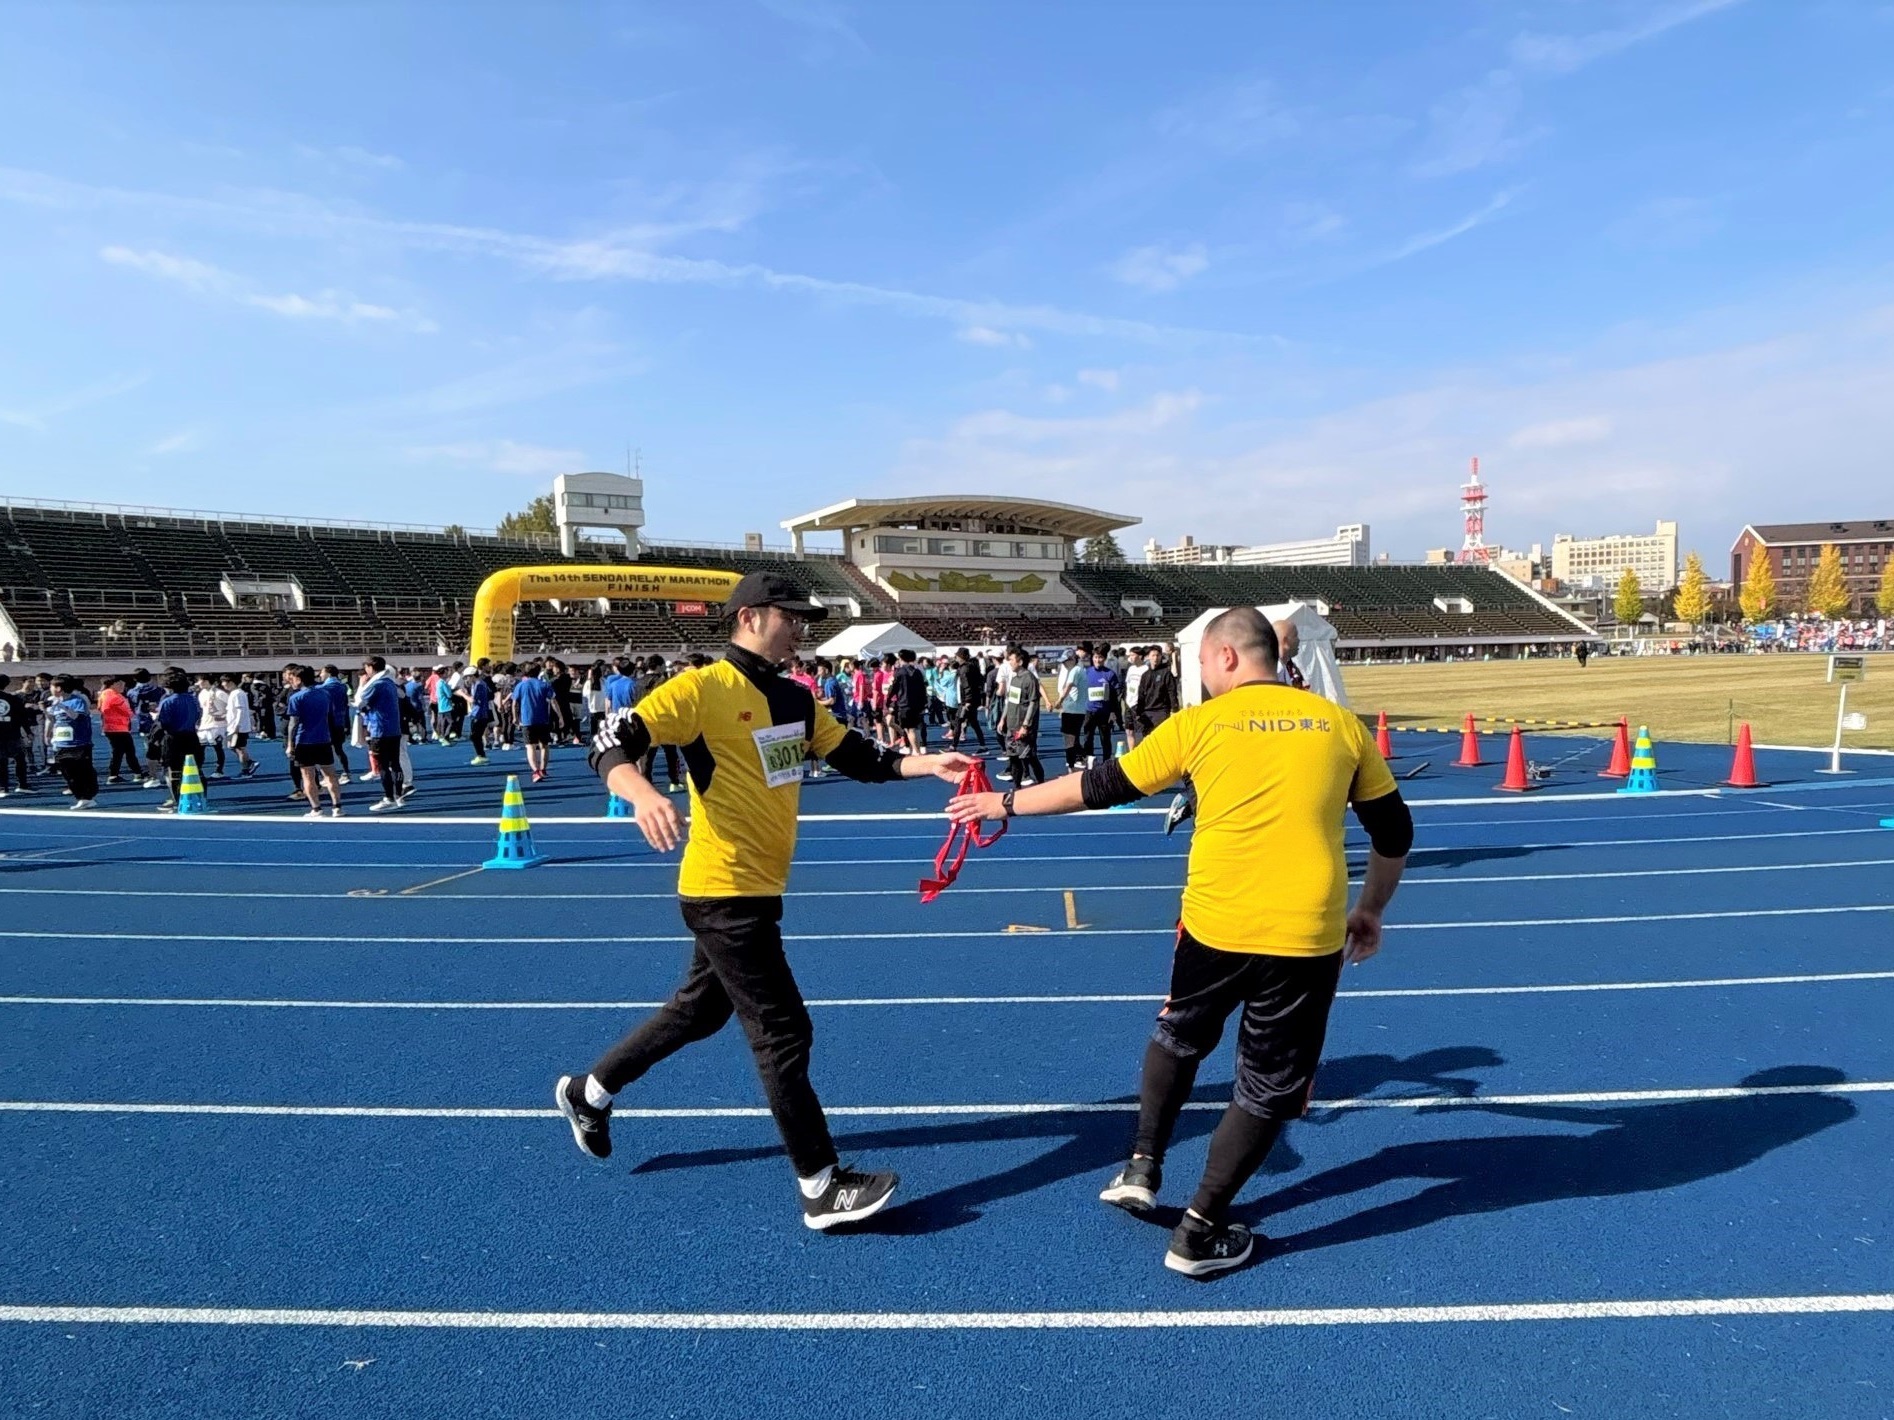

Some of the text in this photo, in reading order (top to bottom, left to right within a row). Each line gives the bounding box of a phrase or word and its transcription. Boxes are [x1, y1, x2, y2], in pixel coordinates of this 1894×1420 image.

[528, 573, 730, 586] The 14th SENDAI RELAY MARATHON
[608, 583, 660, 592] FINISH
[833, 1189, 858, 1210] N
